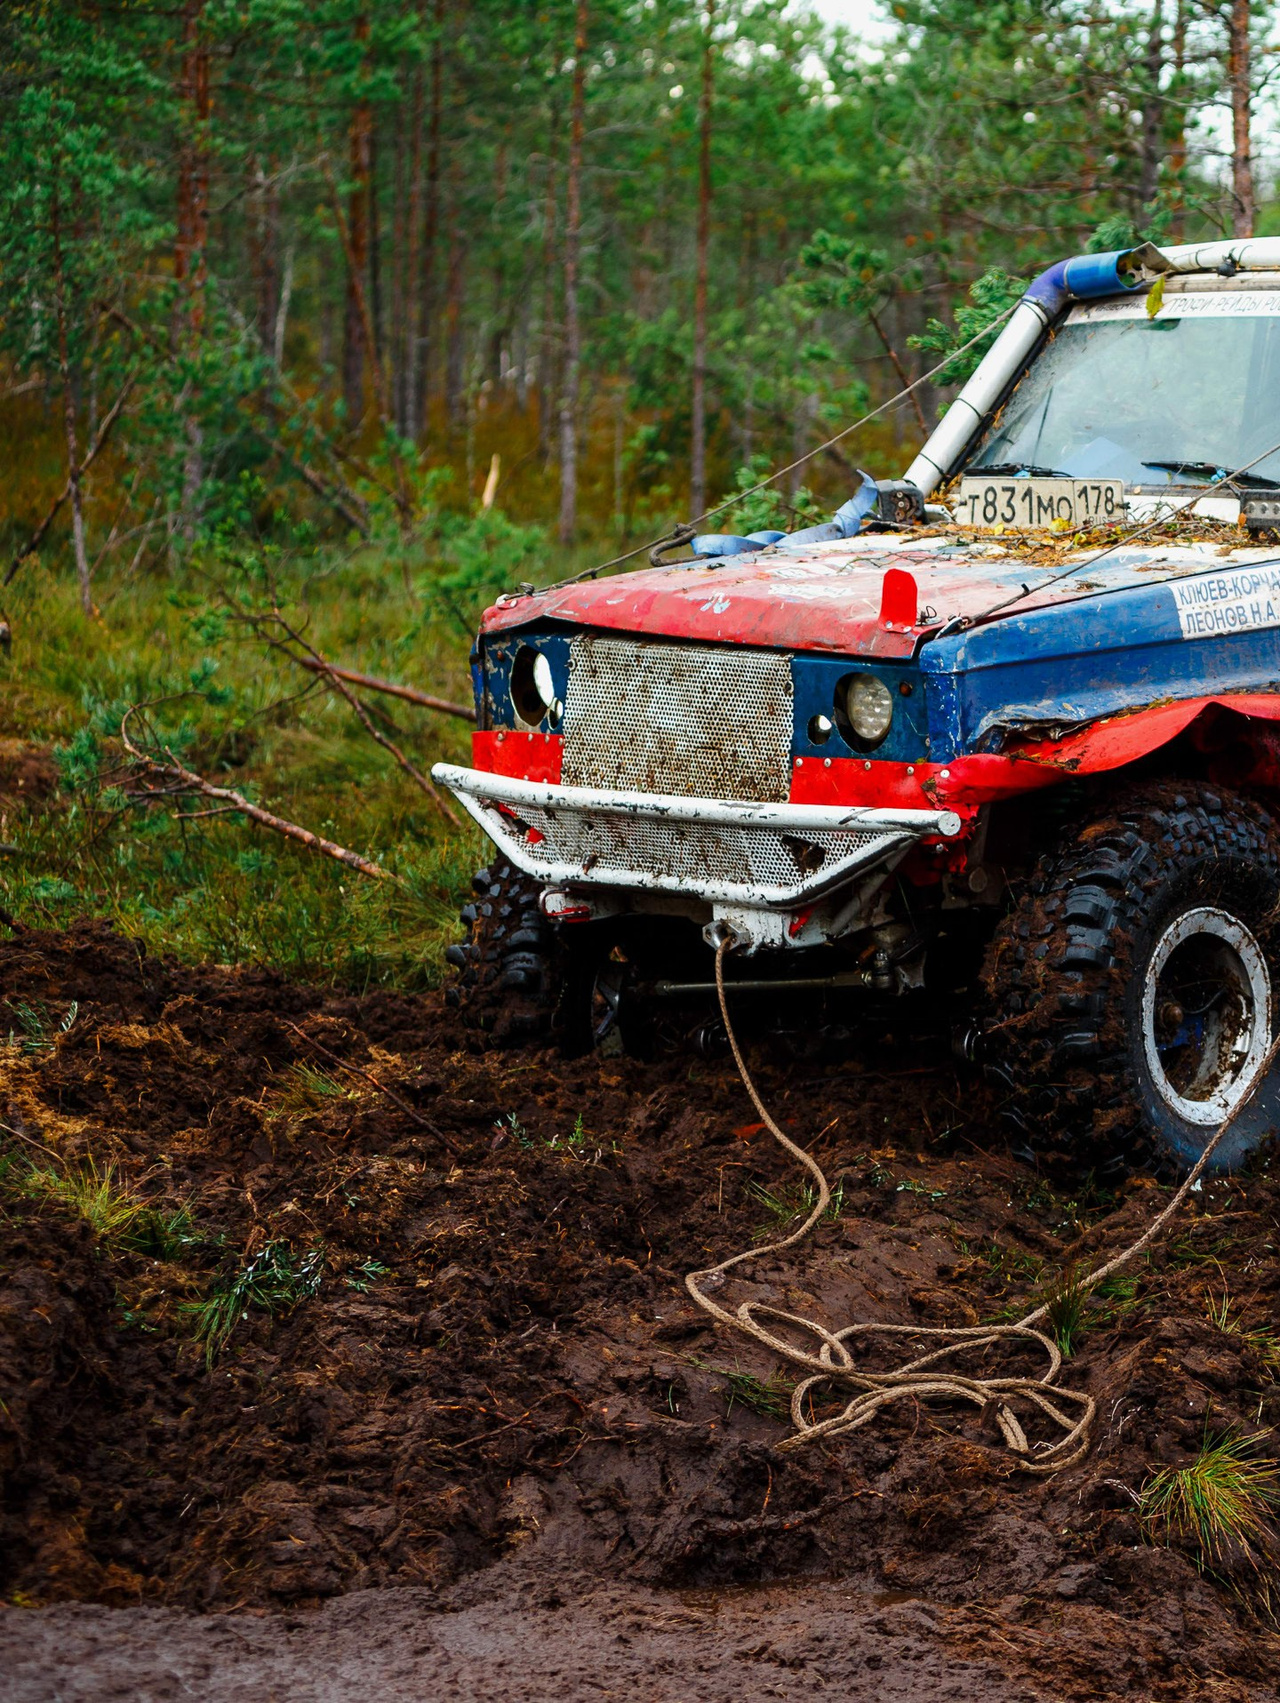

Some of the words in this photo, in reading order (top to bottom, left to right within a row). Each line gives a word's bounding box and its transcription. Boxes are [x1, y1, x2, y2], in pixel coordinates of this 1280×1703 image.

[1077, 485, 1114, 515] 178
[1186, 606, 1248, 635] ЛЕОНОВ
[1251, 602, 1280, 624] Н.А.
